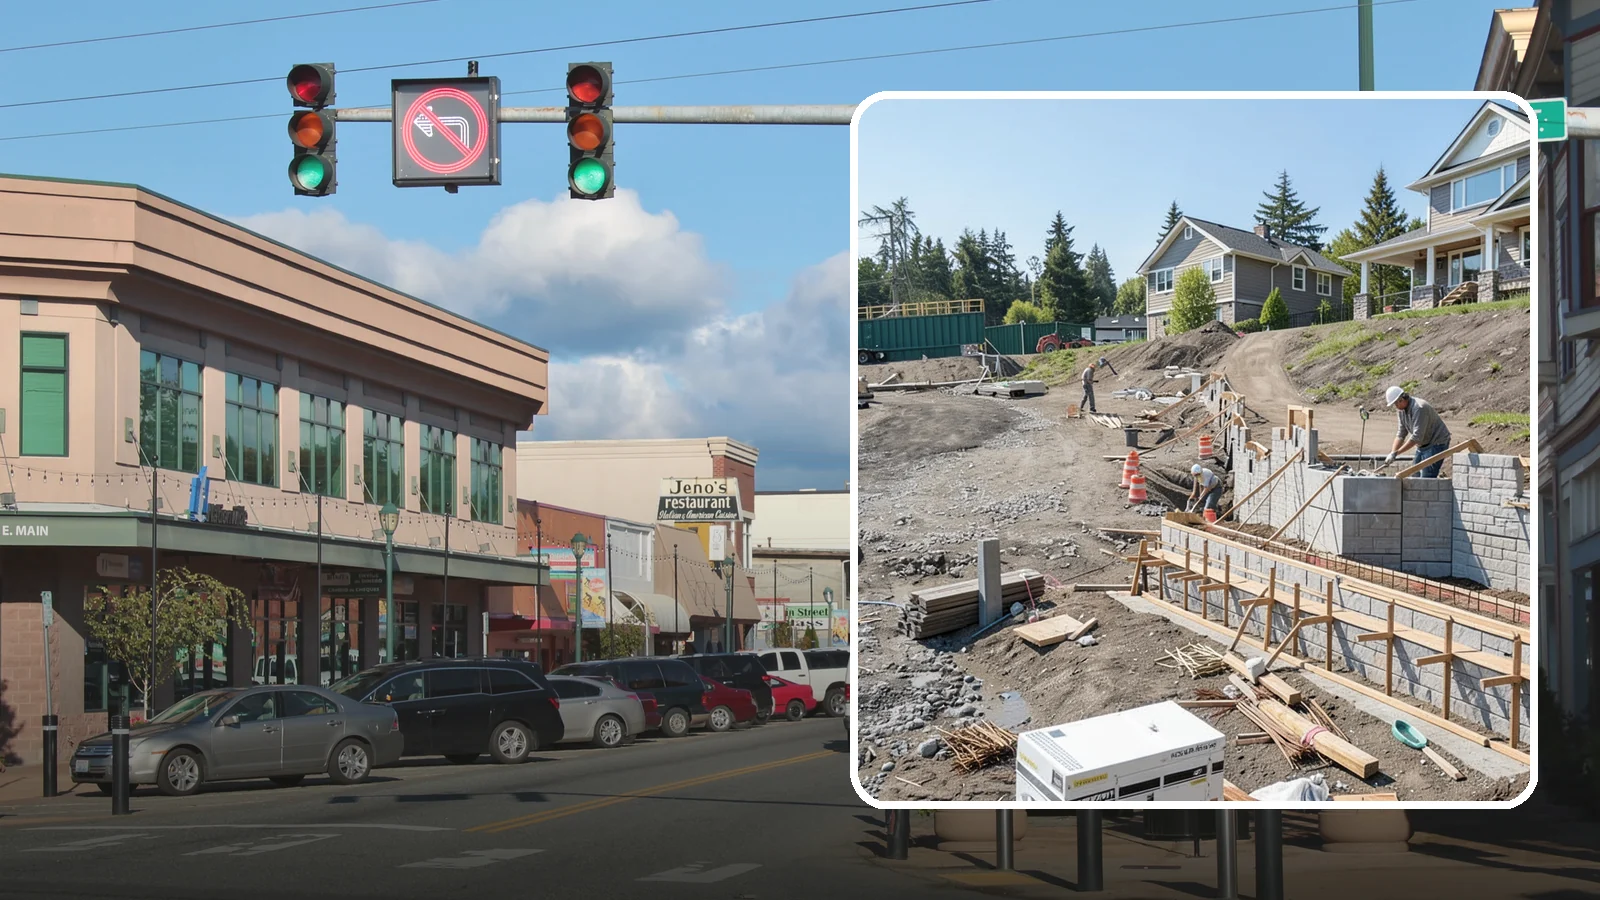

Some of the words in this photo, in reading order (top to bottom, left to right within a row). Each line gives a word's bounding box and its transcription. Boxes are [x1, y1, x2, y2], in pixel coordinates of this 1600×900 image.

[670, 480, 727, 494] Jeno's
[665, 496, 731, 509] restaurant
[659, 510, 681, 520] Italian
[686, 510, 714, 519] American
[715, 510, 737, 519] Cuisine
[2, 525, 13, 536] E.
[15, 525, 49, 536] MAIN
[797, 607, 828, 616] Street
[791, 619, 823, 627] lass
